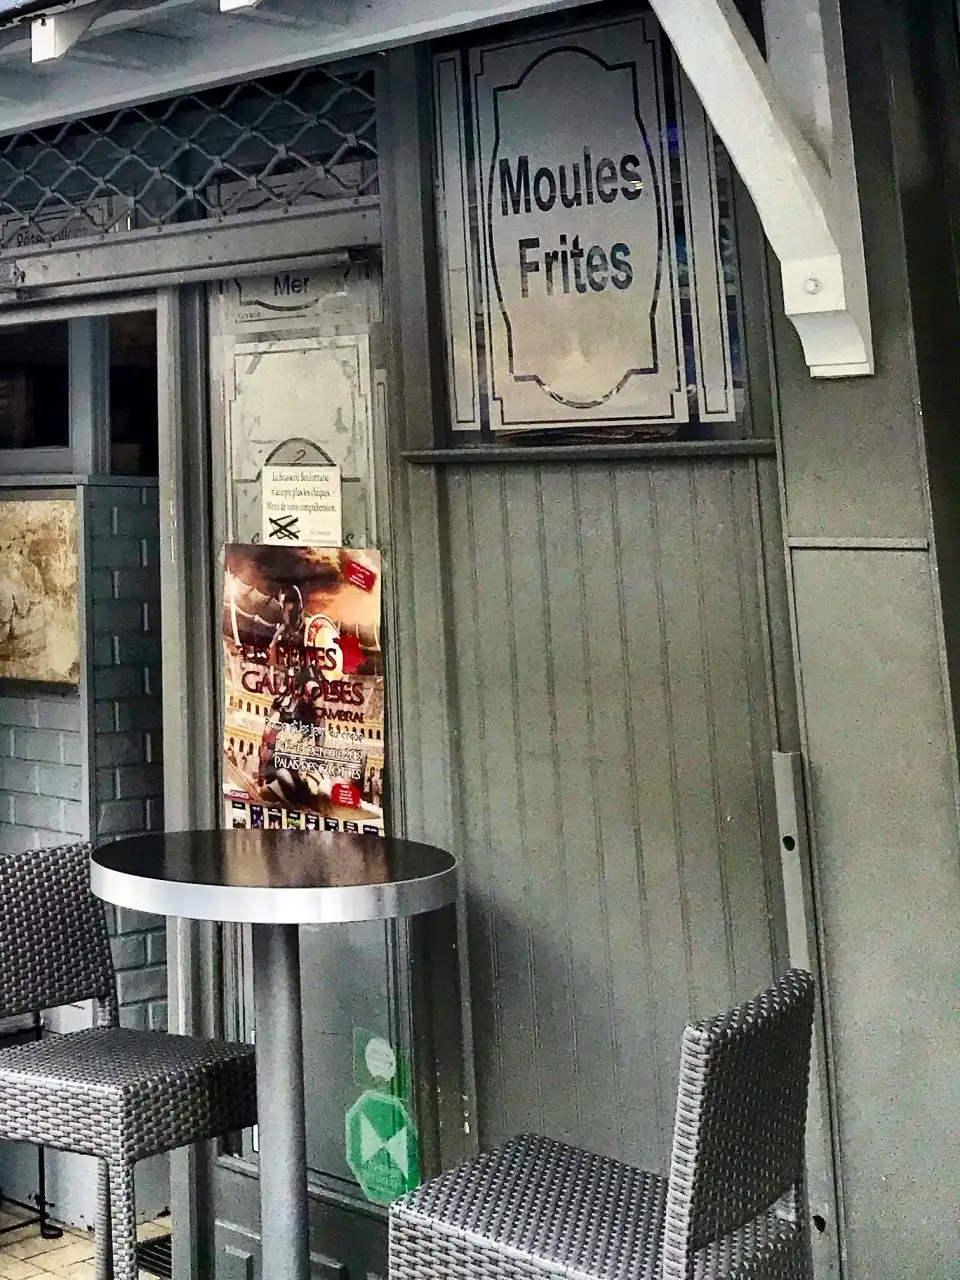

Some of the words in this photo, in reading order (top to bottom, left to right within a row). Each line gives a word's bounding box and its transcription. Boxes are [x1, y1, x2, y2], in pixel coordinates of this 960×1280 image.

[498, 145, 644, 217] Moules
[274, 274, 310, 296] Mer
[518, 234, 634, 298] Frites
[242, 670, 365, 706] GAULOISES
